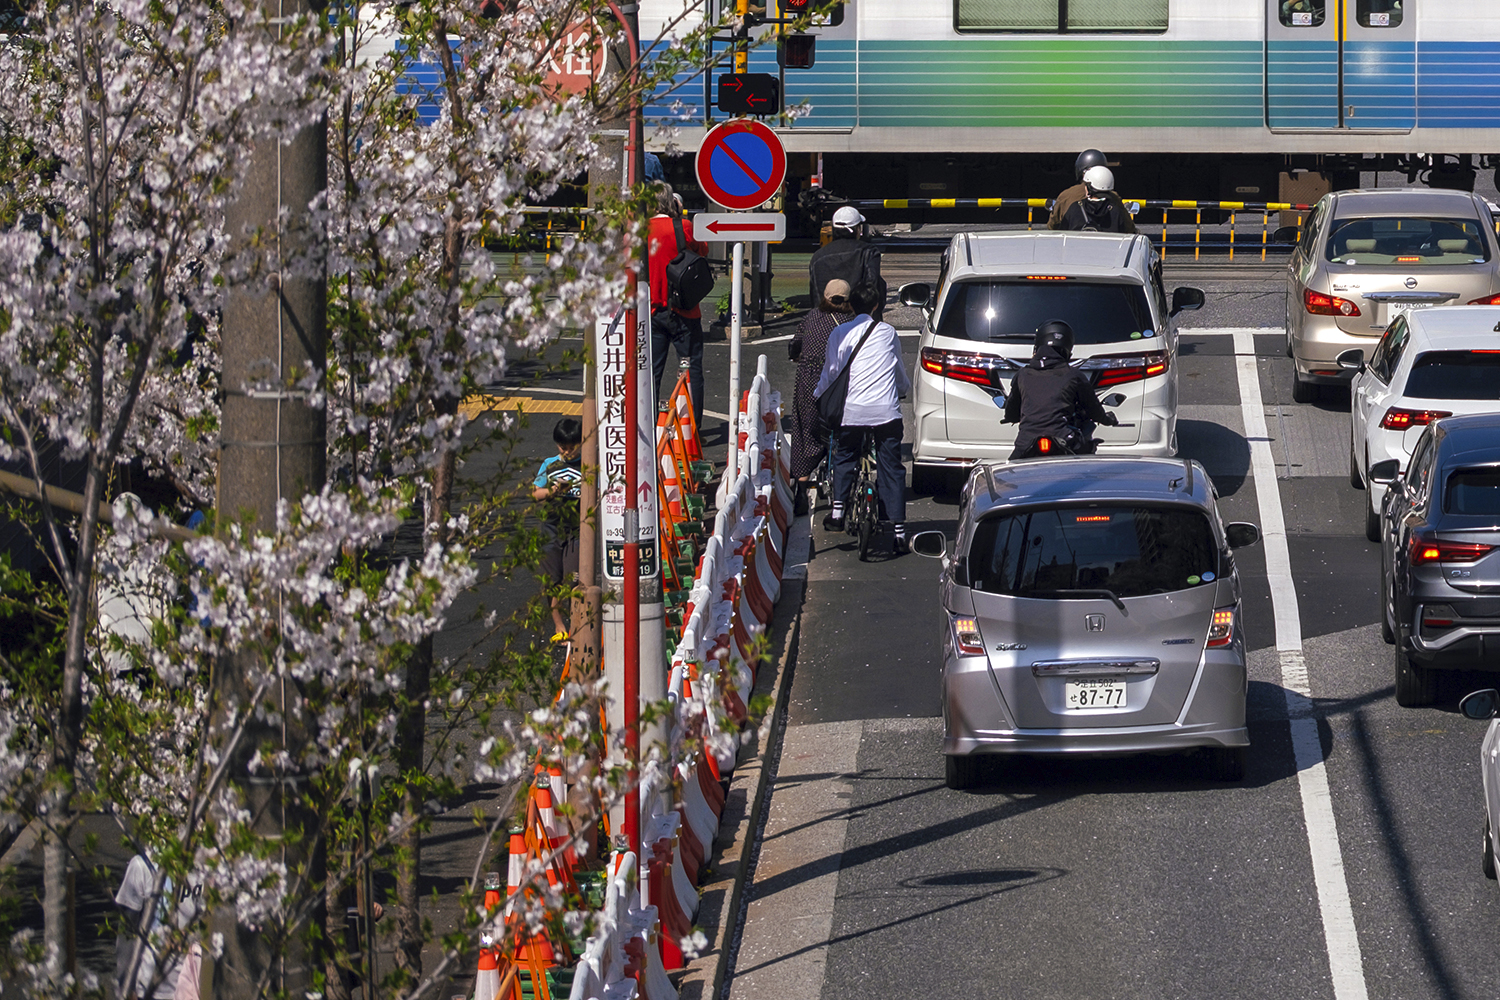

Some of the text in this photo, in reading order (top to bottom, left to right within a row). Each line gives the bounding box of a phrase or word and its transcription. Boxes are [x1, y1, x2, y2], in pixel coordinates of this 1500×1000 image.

[1098, 679, 1114, 688] 502
[1070, 689, 1123, 705] せ 87-77
